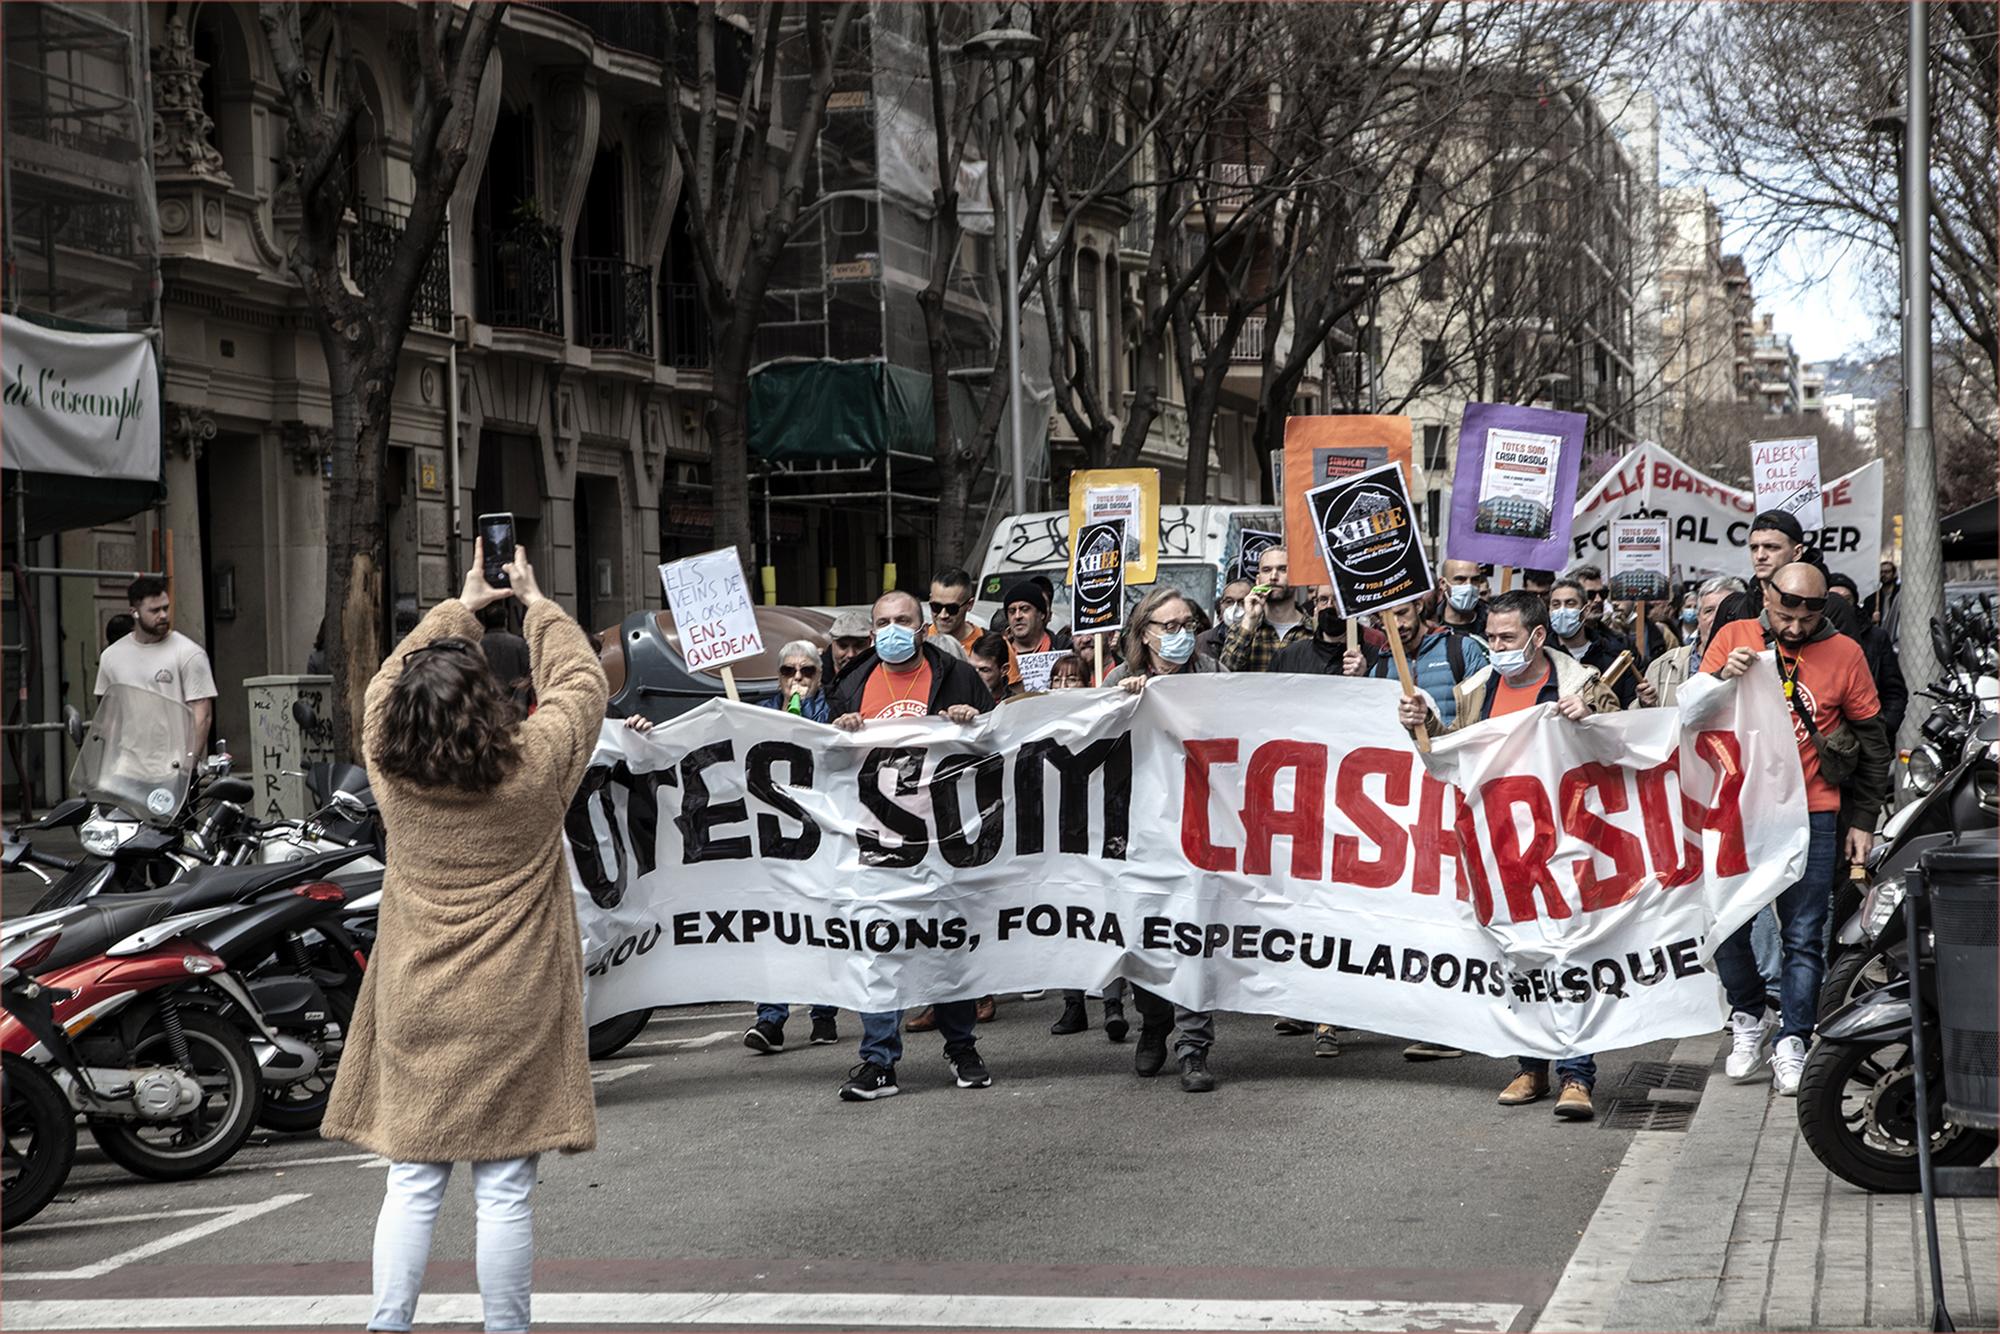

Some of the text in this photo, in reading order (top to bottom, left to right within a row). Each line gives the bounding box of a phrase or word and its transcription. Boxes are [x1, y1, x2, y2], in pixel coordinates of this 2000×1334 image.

[4, 364, 144, 440] de l'eixample
[1496, 452, 1548, 466] CASA ORSOLA
[1502, 441, 1546, 455] TOTES SOM
[1755, 446, 1808, 465] ALBERT
[1766, 462, 1798, 479] OLLÉ
[1328, 507, 1407, 549] XHEE
[1675, 514, 1718, 546] AL
[1078, 550, 1120, 575] XHEE
[665, 562, 704, 591] ELS
[724, 574, 741, 596] DE
[676, 610, 697, 628] LA
[689, 619, 727, 645] ENS
[687, 633, 761, 667] QUEDEM
[564, 738, 822, 909] OTES
[856, 730, 1132, 868] SOM
[673, 909, 982, 953] EXPULSIONS,
[998, 903, 1126, 948] FORA
